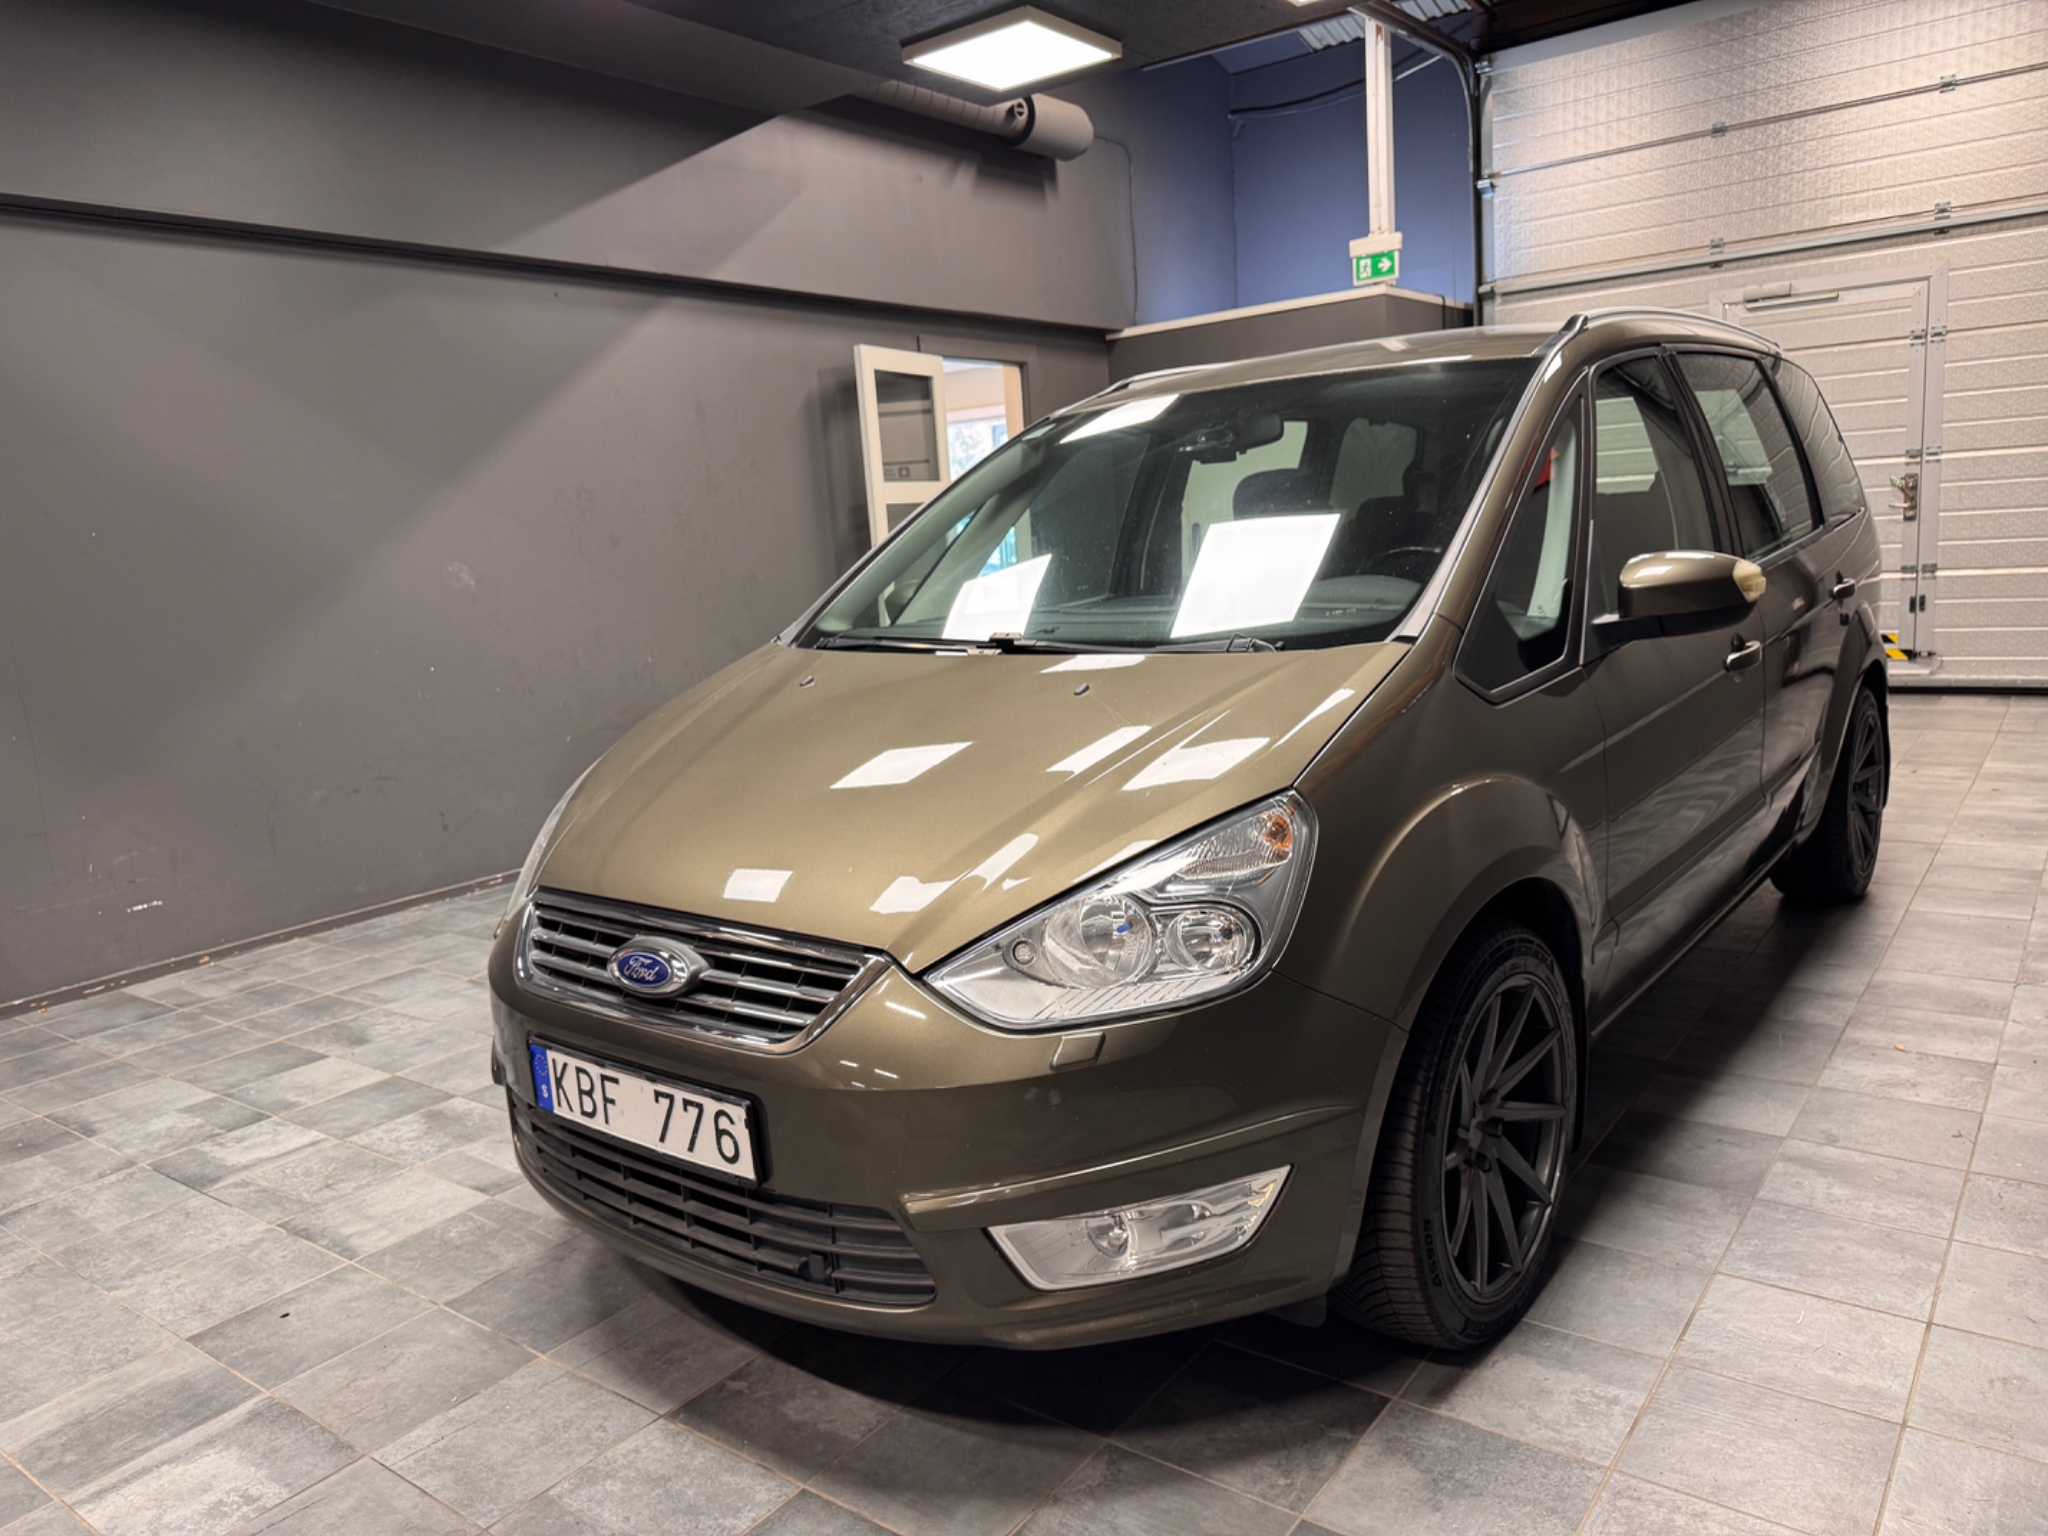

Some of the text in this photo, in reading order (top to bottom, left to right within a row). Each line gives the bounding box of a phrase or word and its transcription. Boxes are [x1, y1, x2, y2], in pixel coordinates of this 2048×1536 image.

[623, 956, 660, 981] Ford
[541, 1083, 549, 1098] S
[551, 1058, 740, 1165] KBF 776
